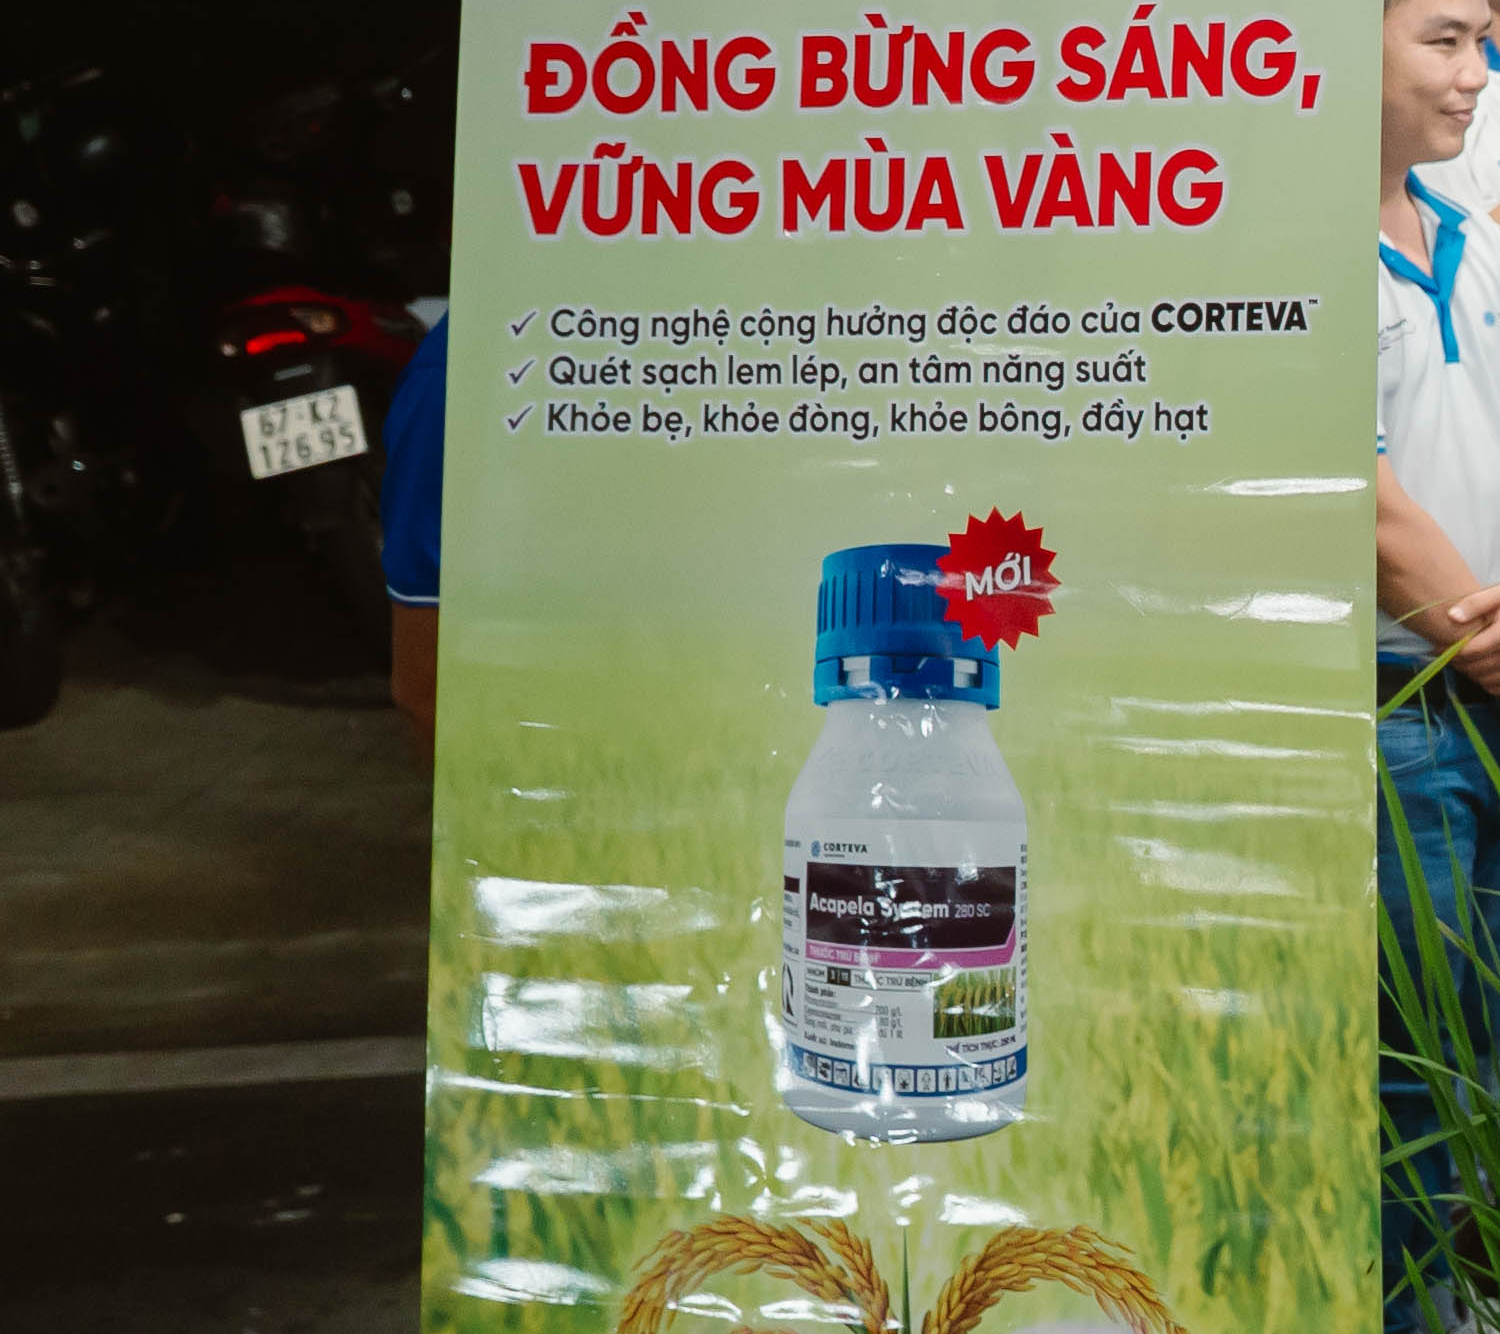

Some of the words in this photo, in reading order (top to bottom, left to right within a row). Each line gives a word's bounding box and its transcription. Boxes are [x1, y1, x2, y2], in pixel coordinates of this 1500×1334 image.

[524, 9, 777, 116] ĐỒNG
[799, 12, 1037, 109] BỪNG
[1056, 3, 1321, 111] SÁNG,
[518, 141, 760, 237] VỮNG
[782, 138, 964, 233] MÙA
[985, 132, 1224, 229] VÀNG
[549, 305, 644, 346] Công
[650, 306, 731, 344] nghệ
[739, 306, 817, 346] cộng
[826, 301, 927, 342] hưởng
[935, 303, 1001, 341] độc
[1008, 300, 1071, 337] đáo
[1080, 300, 1142, 336] của
[548, 354, 632, 390] Quét
[640, 354, 719, 391] sạch
[726, 355, 782, 388] lem
[790, 352, 850, 393] lép,
[858, 360, 900, 386] an
[907, 354, 973, 387] tâm
[980, 352, 1065, 390] năng
[1075, 347, 1147, 385] suất
[546, 401, 633, 436] Khỏe
[640, 401, 694, 441] bẹ,
[703, 401, 781, 436] khỏe
[788, 401, 879, 439] đòng,
[889, 401, 968, 436] khỏe
[978, 400, 1072, 439] bông,
[1082, 398, 1145, 437] đầy
[1153, 398, 1210, 436] hạt
[964, 552, 1033, 602] MỚI
[823, 842, 868, 853] CORTEVA
[809, 892, 875, 918] Acapela
[955, 903, 975, 917] 280
[976, 903, 991, 917] SC
